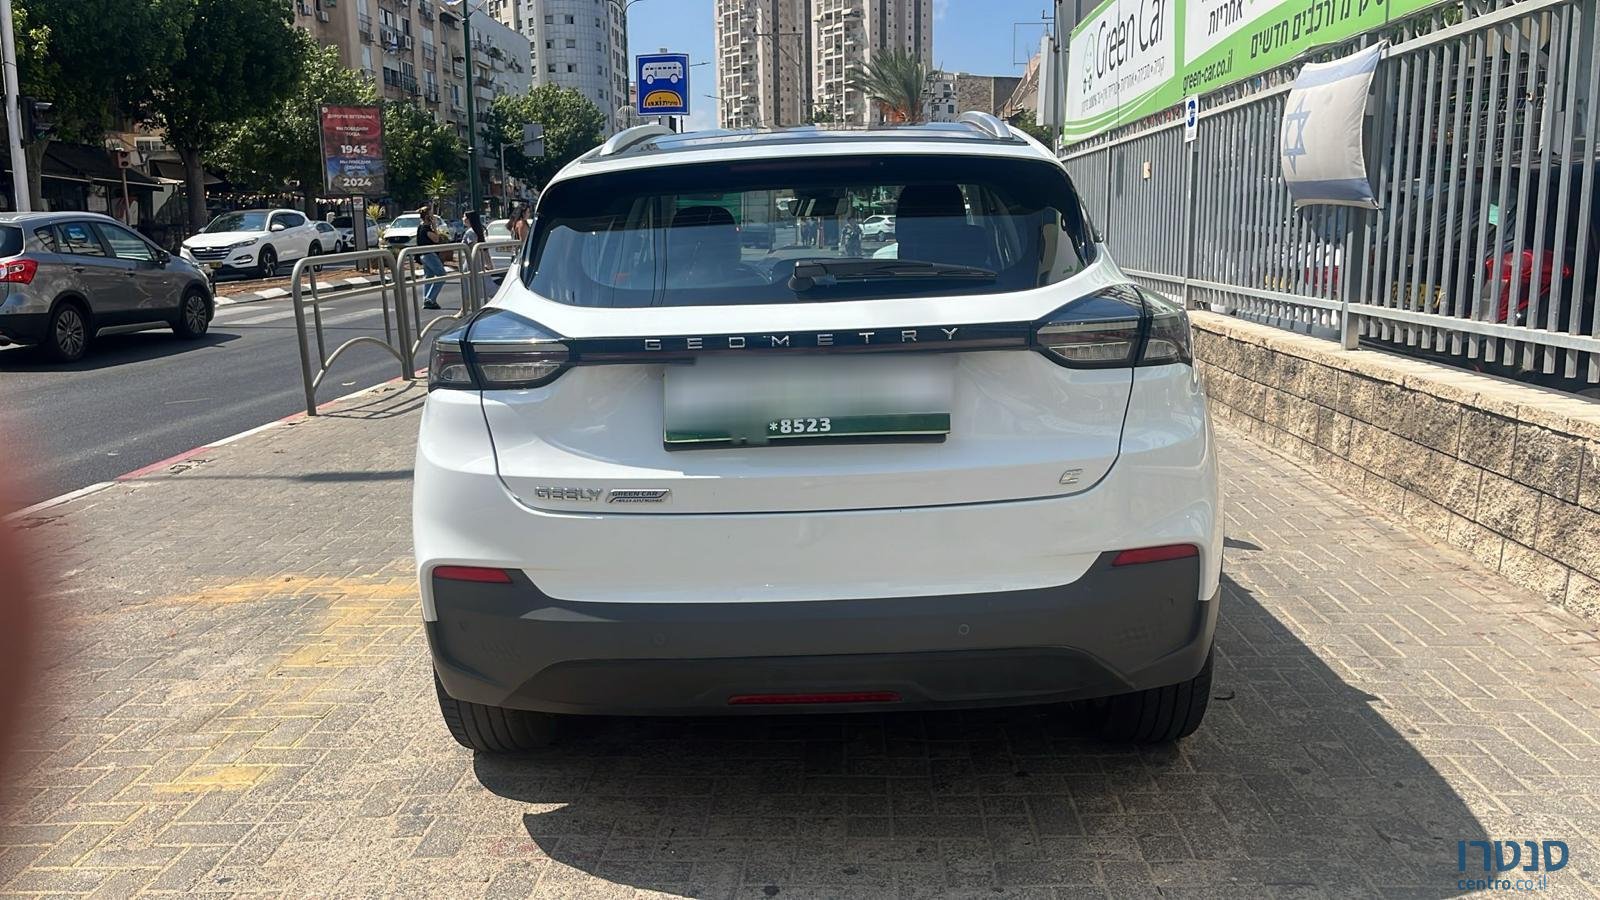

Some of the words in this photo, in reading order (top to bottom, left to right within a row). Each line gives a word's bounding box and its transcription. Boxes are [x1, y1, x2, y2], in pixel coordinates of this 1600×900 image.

[1208, 0, 1243, 37] אחריות
[1096, 13, 1135, 79] Green
[1139, 0, 1165, 52] Car
[1250, 17, 1289, 59] חדשים
[1183, 48, 1234, 97] green-car.co.il
[340, 145, 368, 154] 1945
[343, 178, 372, 187] 2024
[644, 327, 959, 350] GEOMETRY
[534, 485, 603, 501] GEELY
